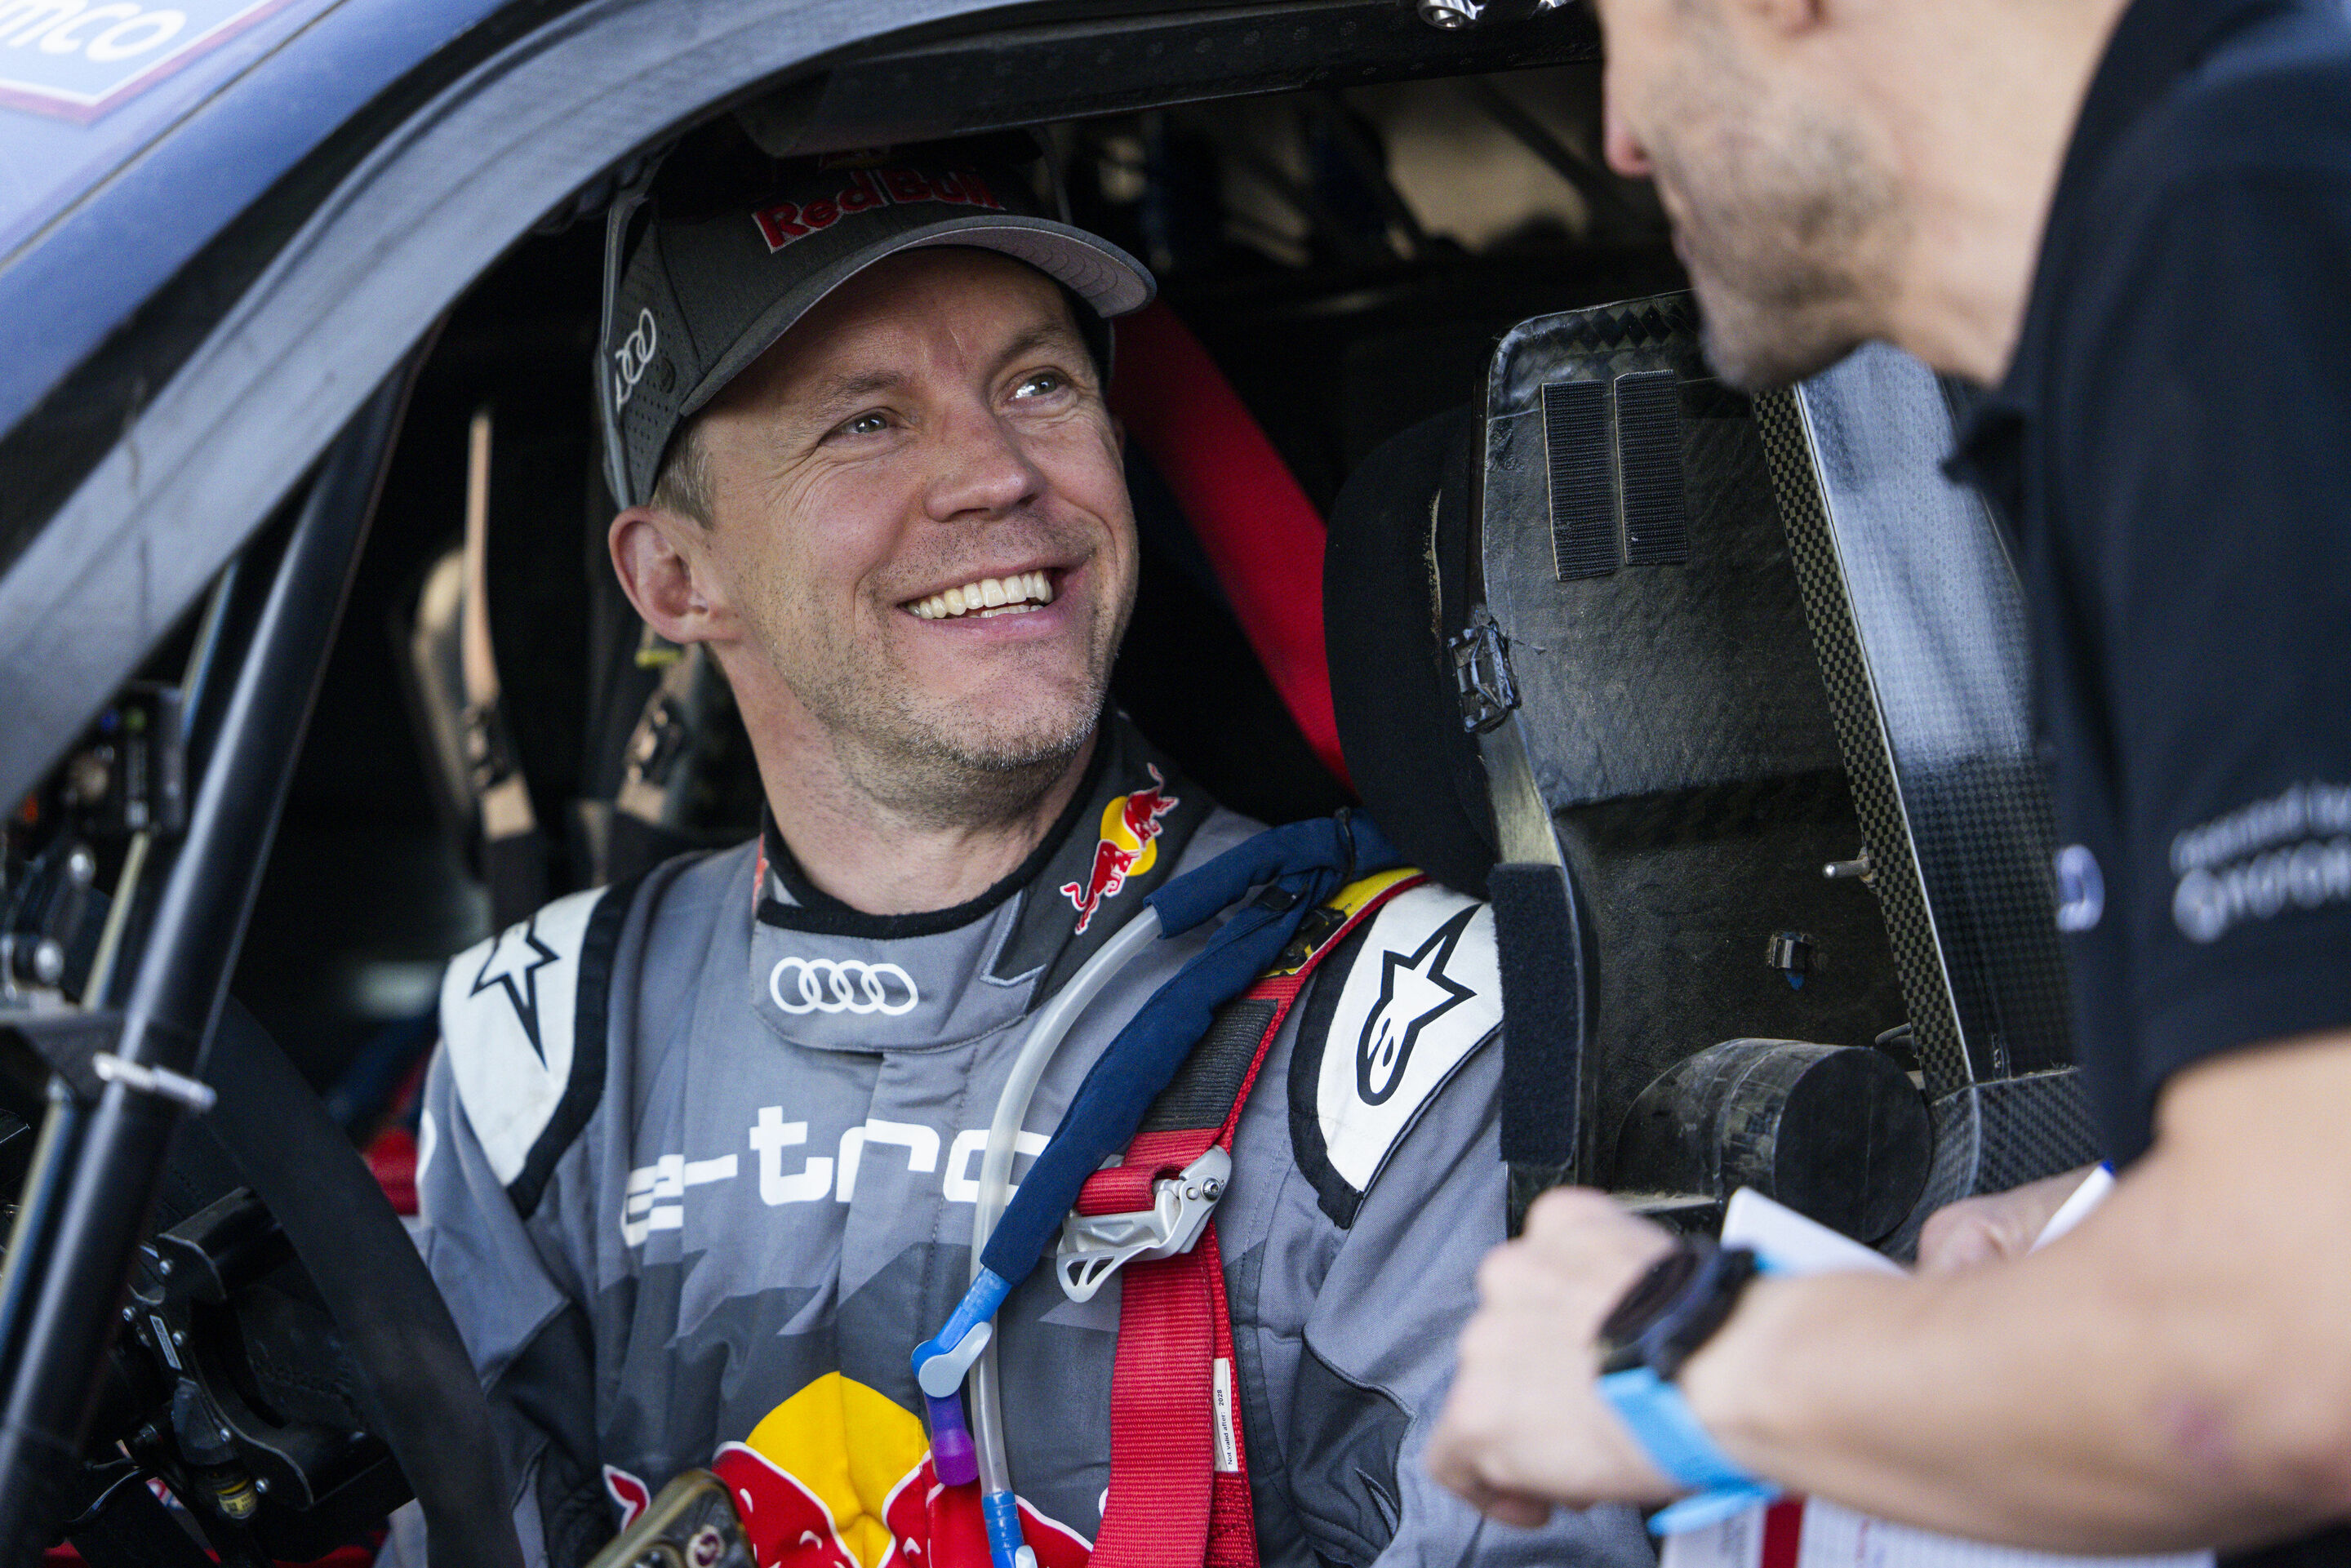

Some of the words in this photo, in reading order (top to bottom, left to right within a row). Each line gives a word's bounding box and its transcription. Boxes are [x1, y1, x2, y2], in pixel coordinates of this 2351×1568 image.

[751, 170, 890, 254] Red
[873, 167, 1007, 211] Bull
[621, 1104, 1125, 1247] e-tro
